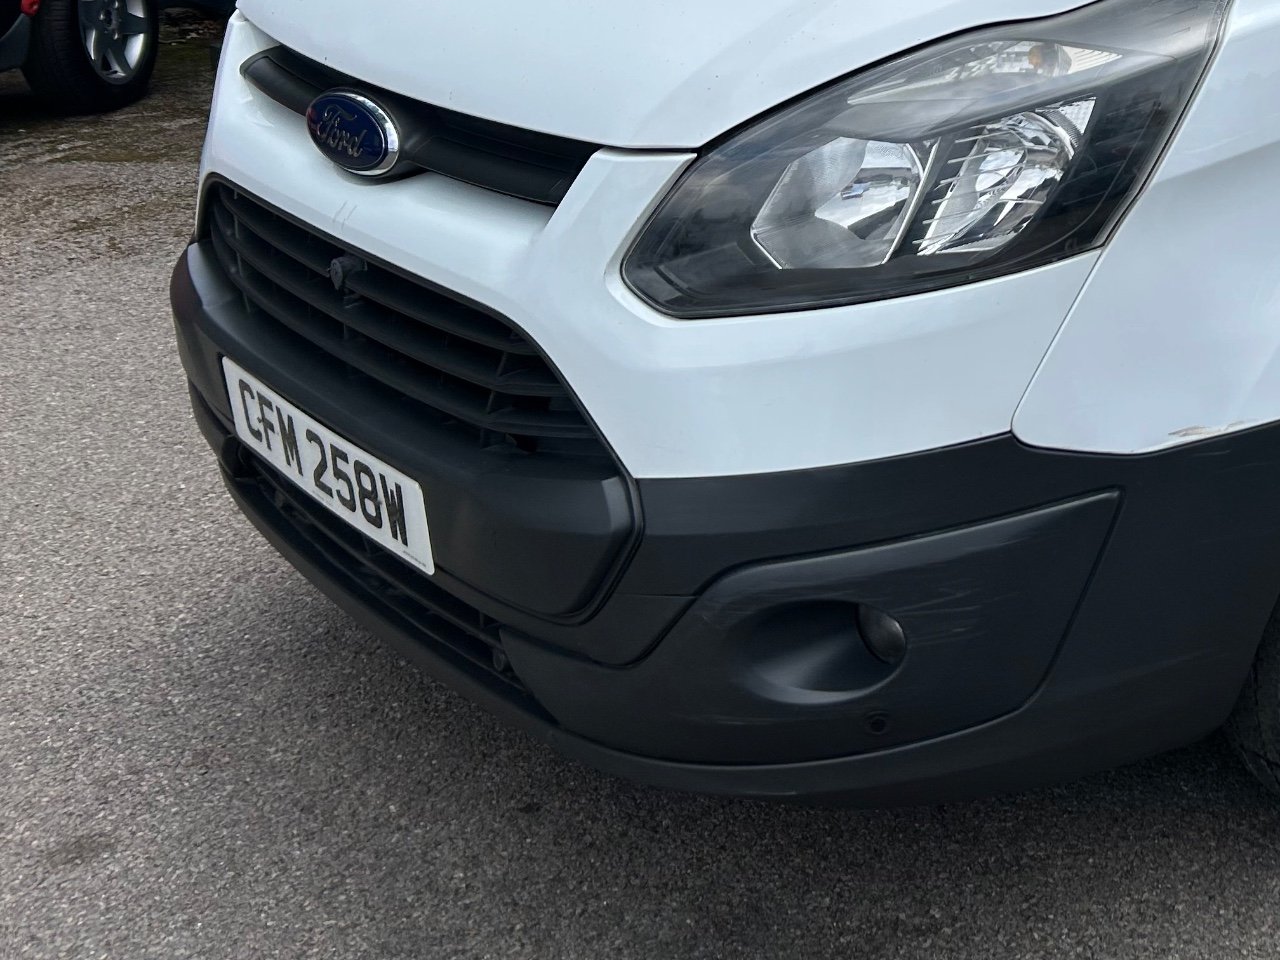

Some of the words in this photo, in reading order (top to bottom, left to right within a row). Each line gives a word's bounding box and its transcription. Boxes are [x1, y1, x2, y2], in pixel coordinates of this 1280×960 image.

[317, 104, 368, 158] Ford
[238, 378, 304, 477] CFM
[305, 428, 409, 547] 258W
